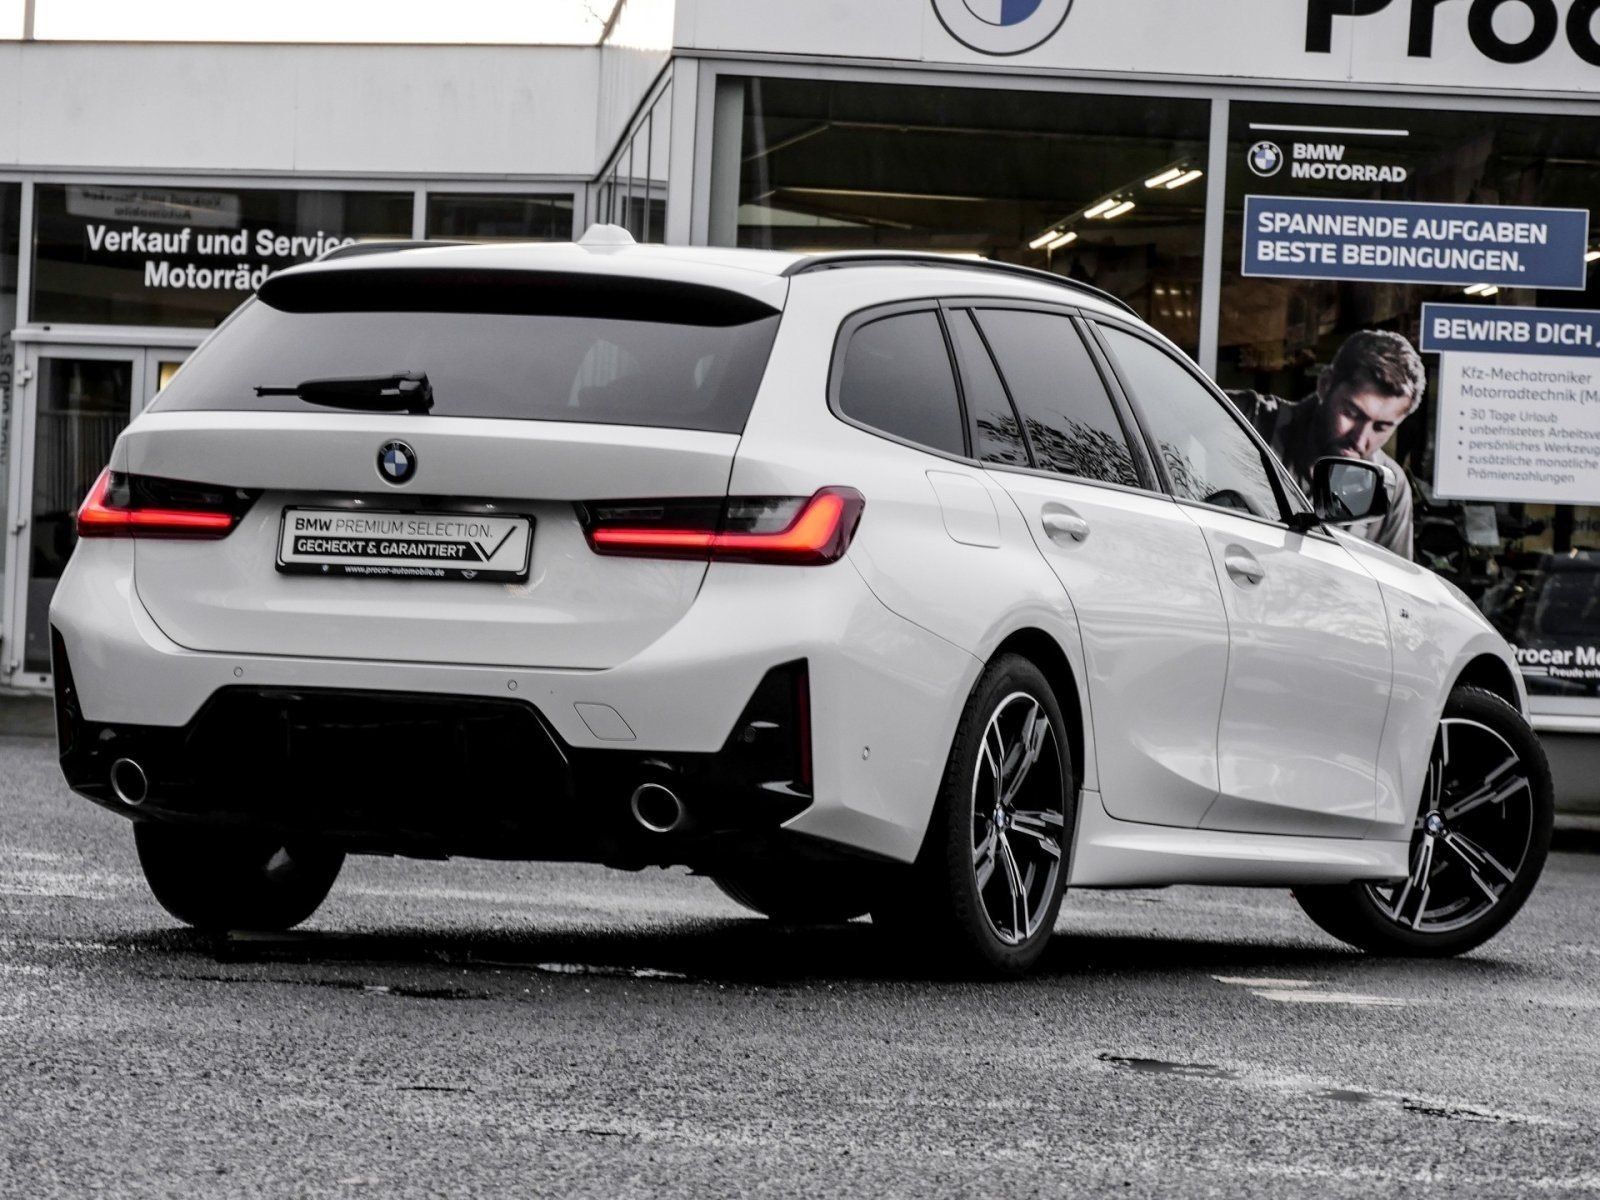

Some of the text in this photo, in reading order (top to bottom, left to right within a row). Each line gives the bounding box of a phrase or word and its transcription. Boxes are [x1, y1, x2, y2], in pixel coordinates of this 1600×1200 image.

[1292, 142, 1345, 161] BMW
[1291, 162, 1407, 182] MOTORRAD
[1257, 212, 1547, 245] SPANNENDE AUFGABEN
[86, 224, 191, 254] Verkauf
[197, 229, 248, 255] und
[1257, 240, 1526, 272] BESTE BEDINGUNGEN.
[144, 261, 280, 290] Motorräd
[1433, 318, 1531, 343] BEWIRB
[1462, 366, 1593, 385] Kfz-Mechatroniker
[1460, 383, 1577, 402] Motorradtechnik
[1470, 408, 1558, 423] 30 Tage Urlaub
[1470, 425, 1545, 438] unbefristetes
[1469, 439, 1541, 453] persönliches
[1468, 454, 1599, 469] zusätzliche monatliche
[1467, 467, 1576, 485] Prämienzahlungen
[295, 518, 494, 538] BMW PREMIUM SELECTION.
[297, 538, 466, 557] GECHECKT & GARANTIERT
[344, 565, 445, 576] www.procar-automobile.de
[1575, 645, 1600, 666] M
